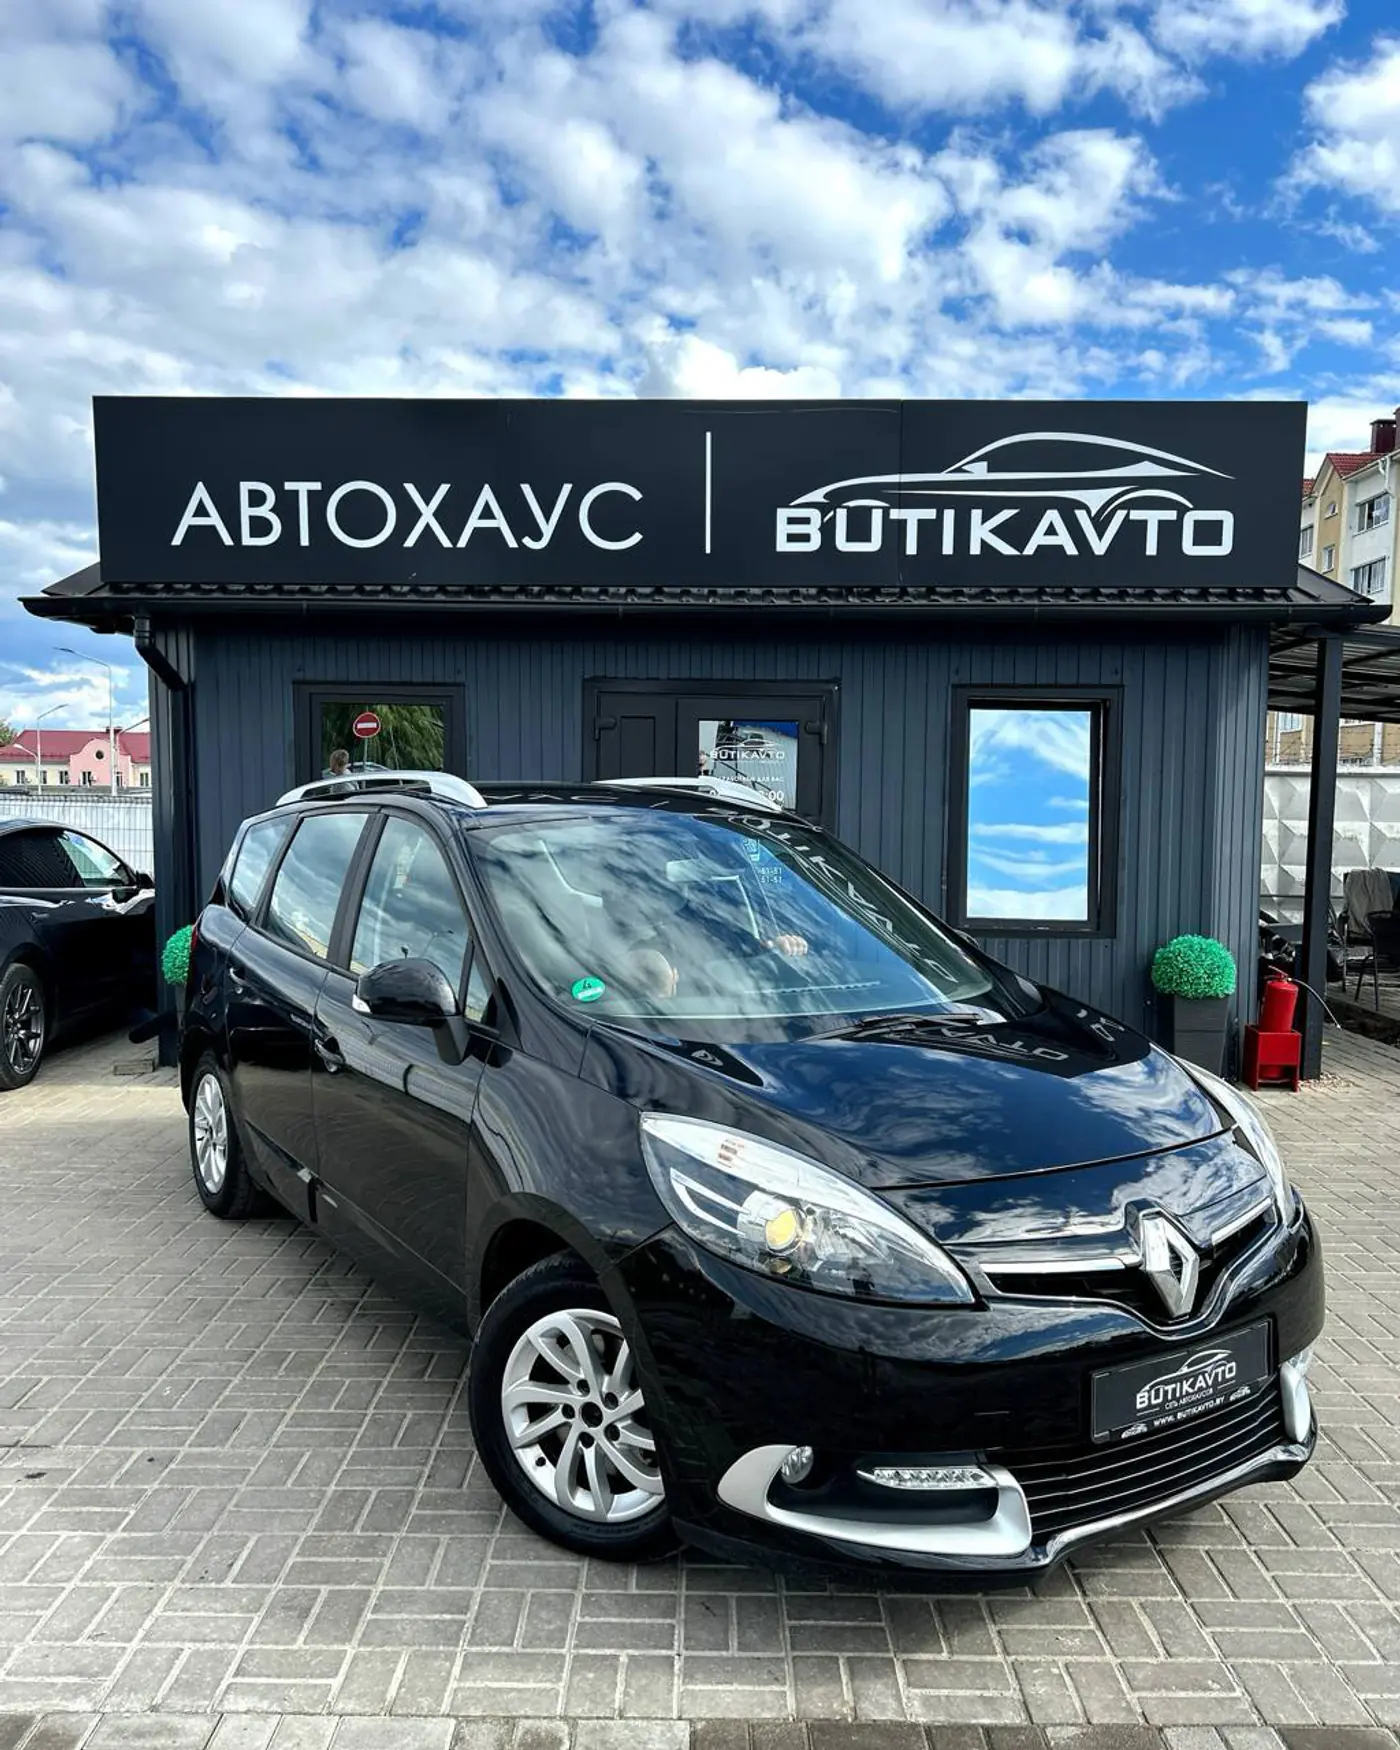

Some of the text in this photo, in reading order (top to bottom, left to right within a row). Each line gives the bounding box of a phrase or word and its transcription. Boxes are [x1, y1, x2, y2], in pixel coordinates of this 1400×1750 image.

[171, 480, 643, 550] АВТОХАУС
[776, 508, 1234, 556] BUTIKAVTO
[710, 750, 785, 760] BUTIKAVTO
[1135, 1361, 1236, 1410] BUTIKAVTO
